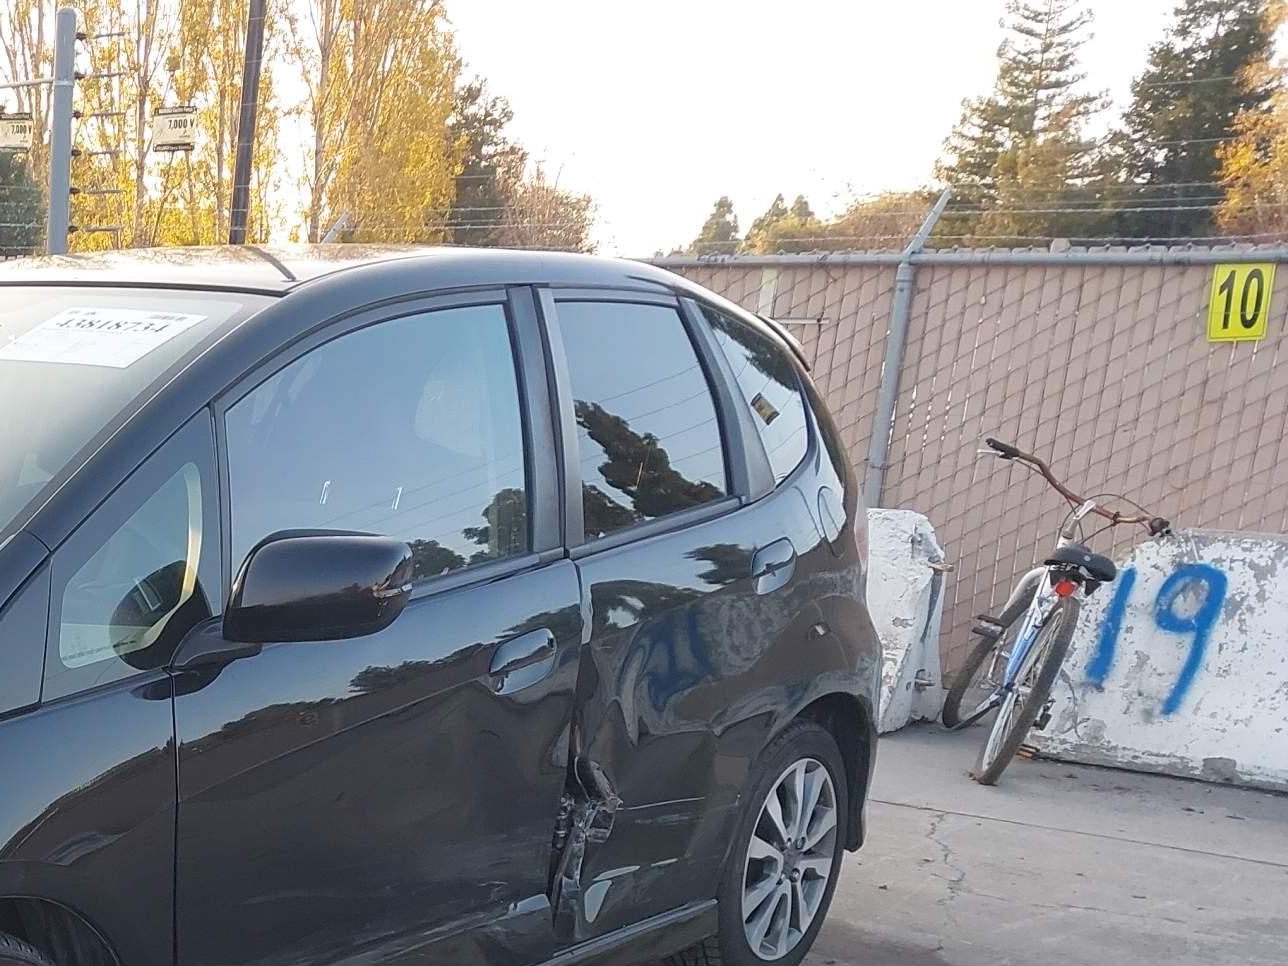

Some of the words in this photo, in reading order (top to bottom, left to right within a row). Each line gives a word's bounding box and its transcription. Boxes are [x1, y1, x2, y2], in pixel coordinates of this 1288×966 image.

[12, 124, 27, 135] 7,000
[168, 118, 187, 130] 7,000
[190, 119, 194, 128] V
[1219, 268, 1264, 329] 10
[1085, 563, 1228, 716] 19
